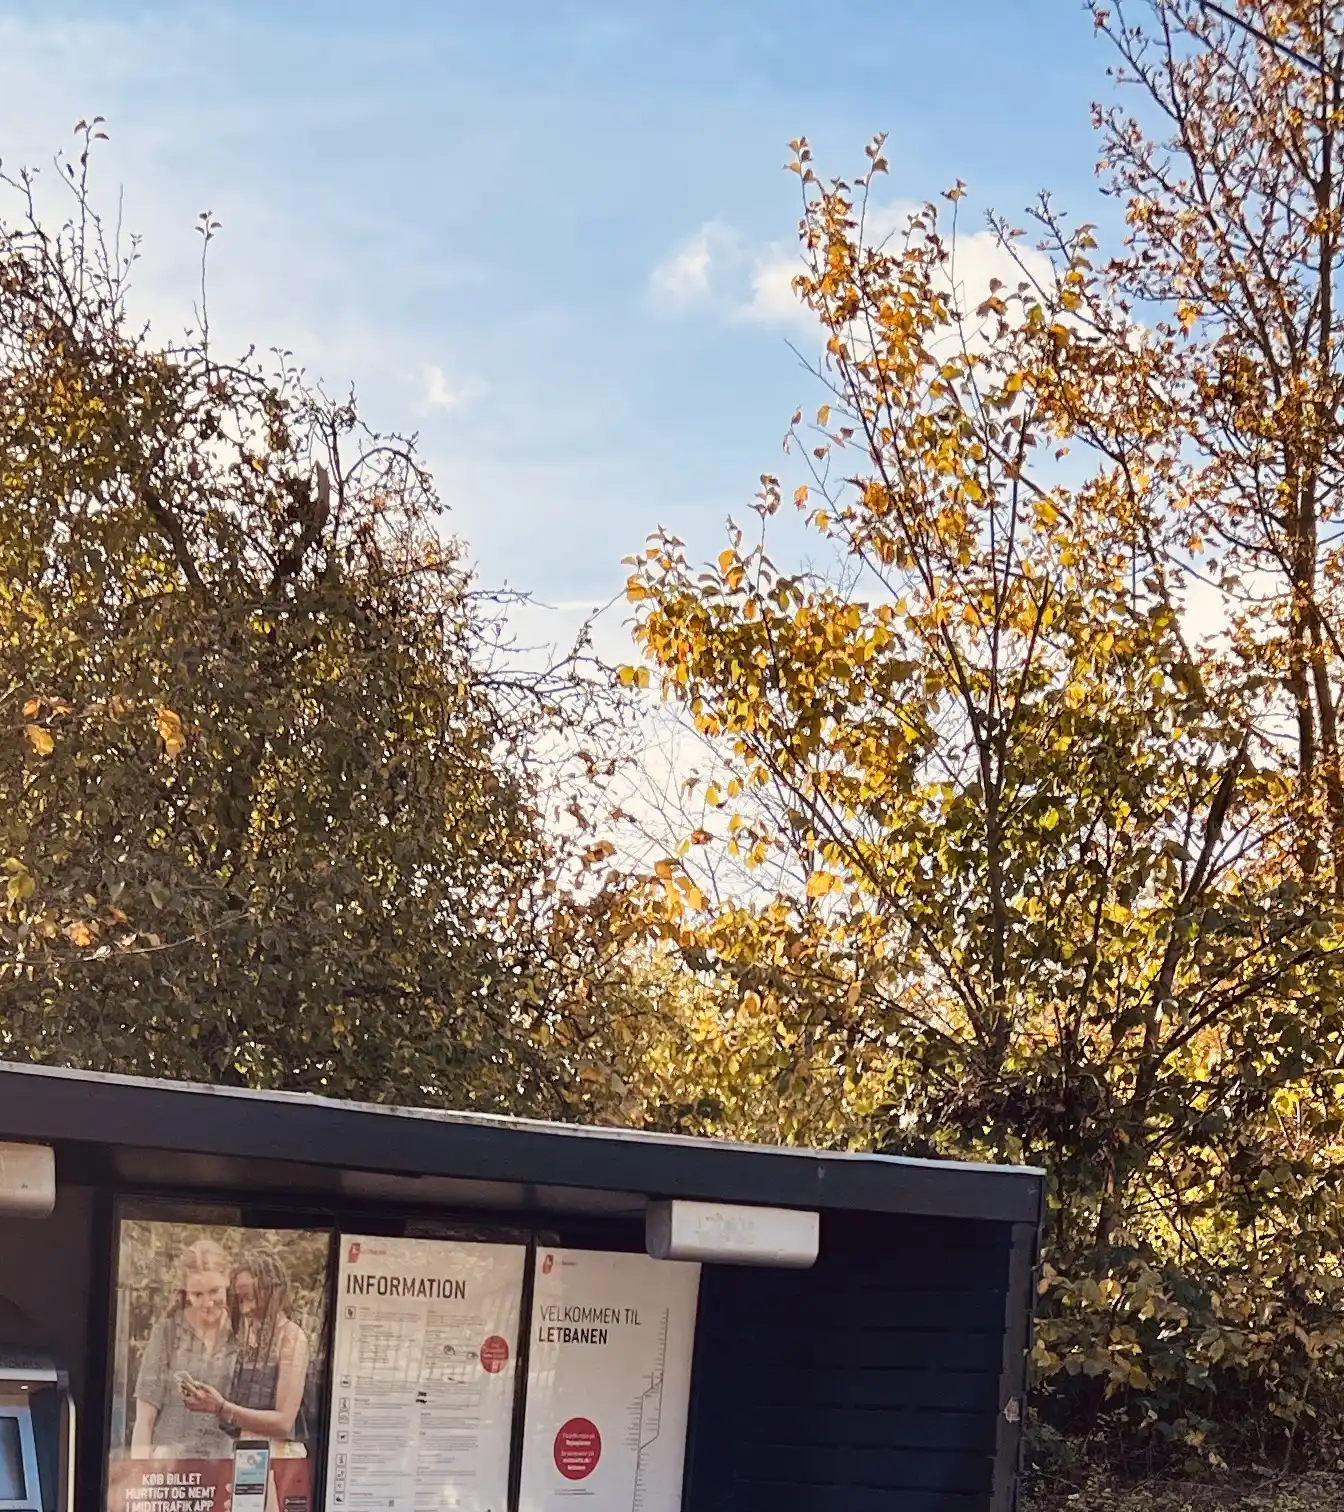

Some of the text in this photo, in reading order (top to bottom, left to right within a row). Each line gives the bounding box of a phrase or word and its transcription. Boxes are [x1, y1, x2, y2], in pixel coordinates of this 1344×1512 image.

[346, 1273, 466, 1300] INFORMATION
[540, 1304, 642, 1325] VELKOMMEN TIL
[538, 1326, 608, 1345] LETBANEN
[141, 1472, 202, 1486] KØB BILLET
[125, 1486, 216, 1500] HURTIGT OG NEMT
[193, 1500, 215, 1512] APP
